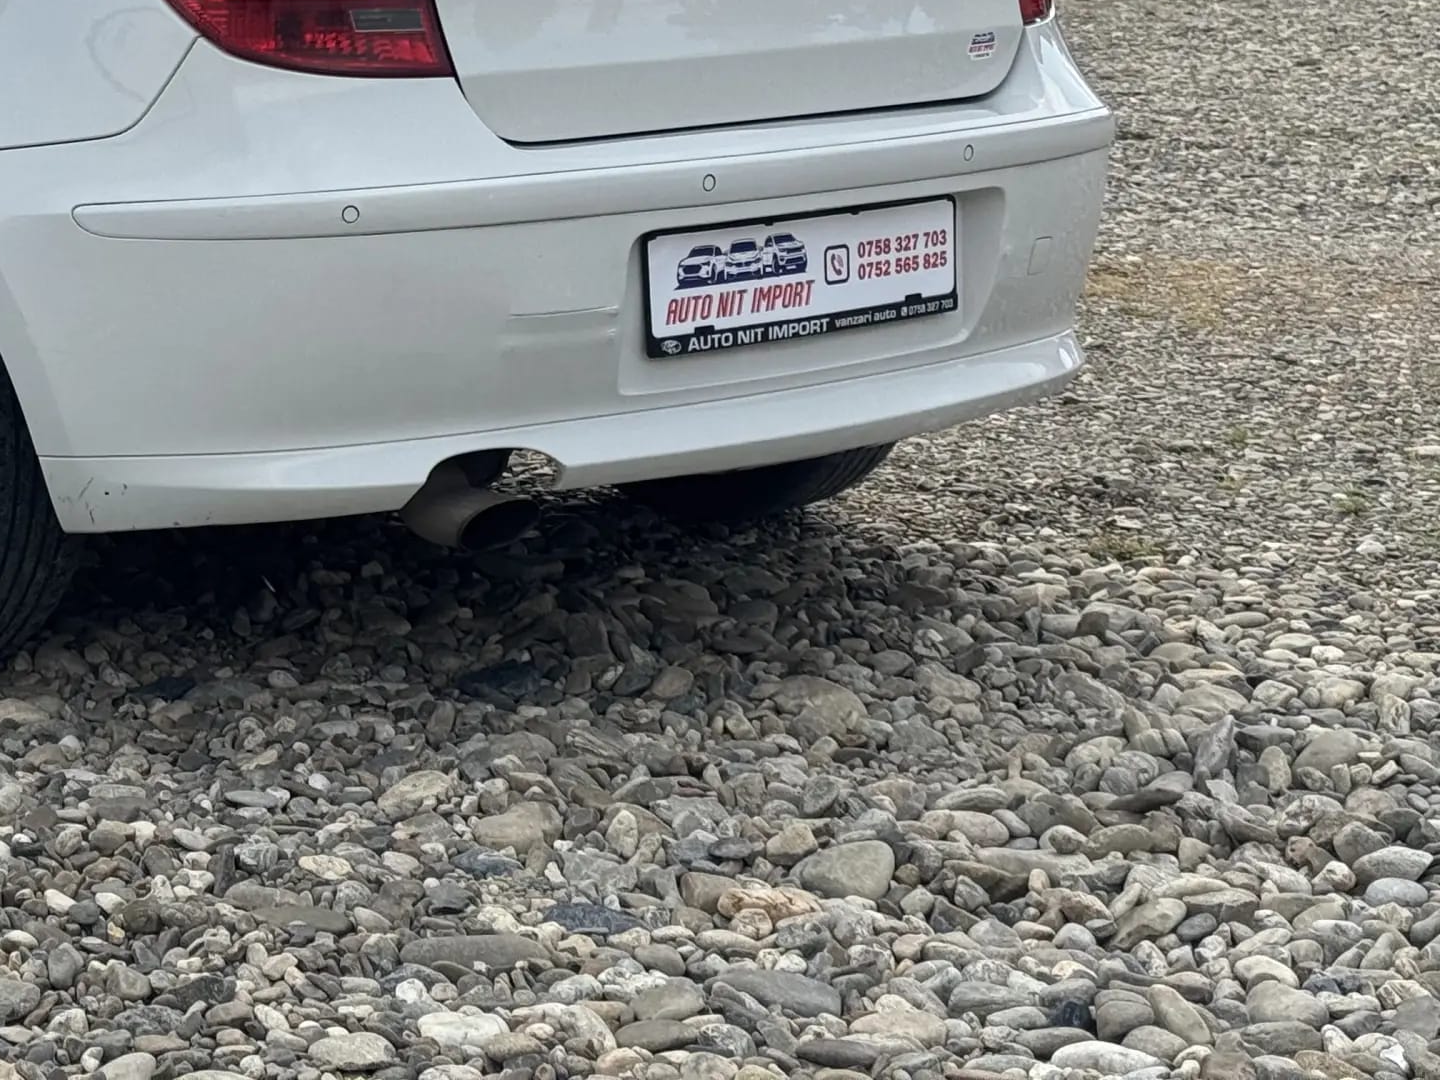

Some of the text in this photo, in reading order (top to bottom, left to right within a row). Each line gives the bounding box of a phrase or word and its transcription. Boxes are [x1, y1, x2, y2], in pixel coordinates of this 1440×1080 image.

[857, 228, 947, 259] 0758 327 703
[857, 250, 948, 281] 0752 565 825
[665, 279, 816, 326] AUTO NIT IMPORT
[687, 332, 734, 353] AUTO
[737, 327, 765, 345] NIT
[768, 318, 830, 341] IMPORT
[873, 308, 897, 322] auto
